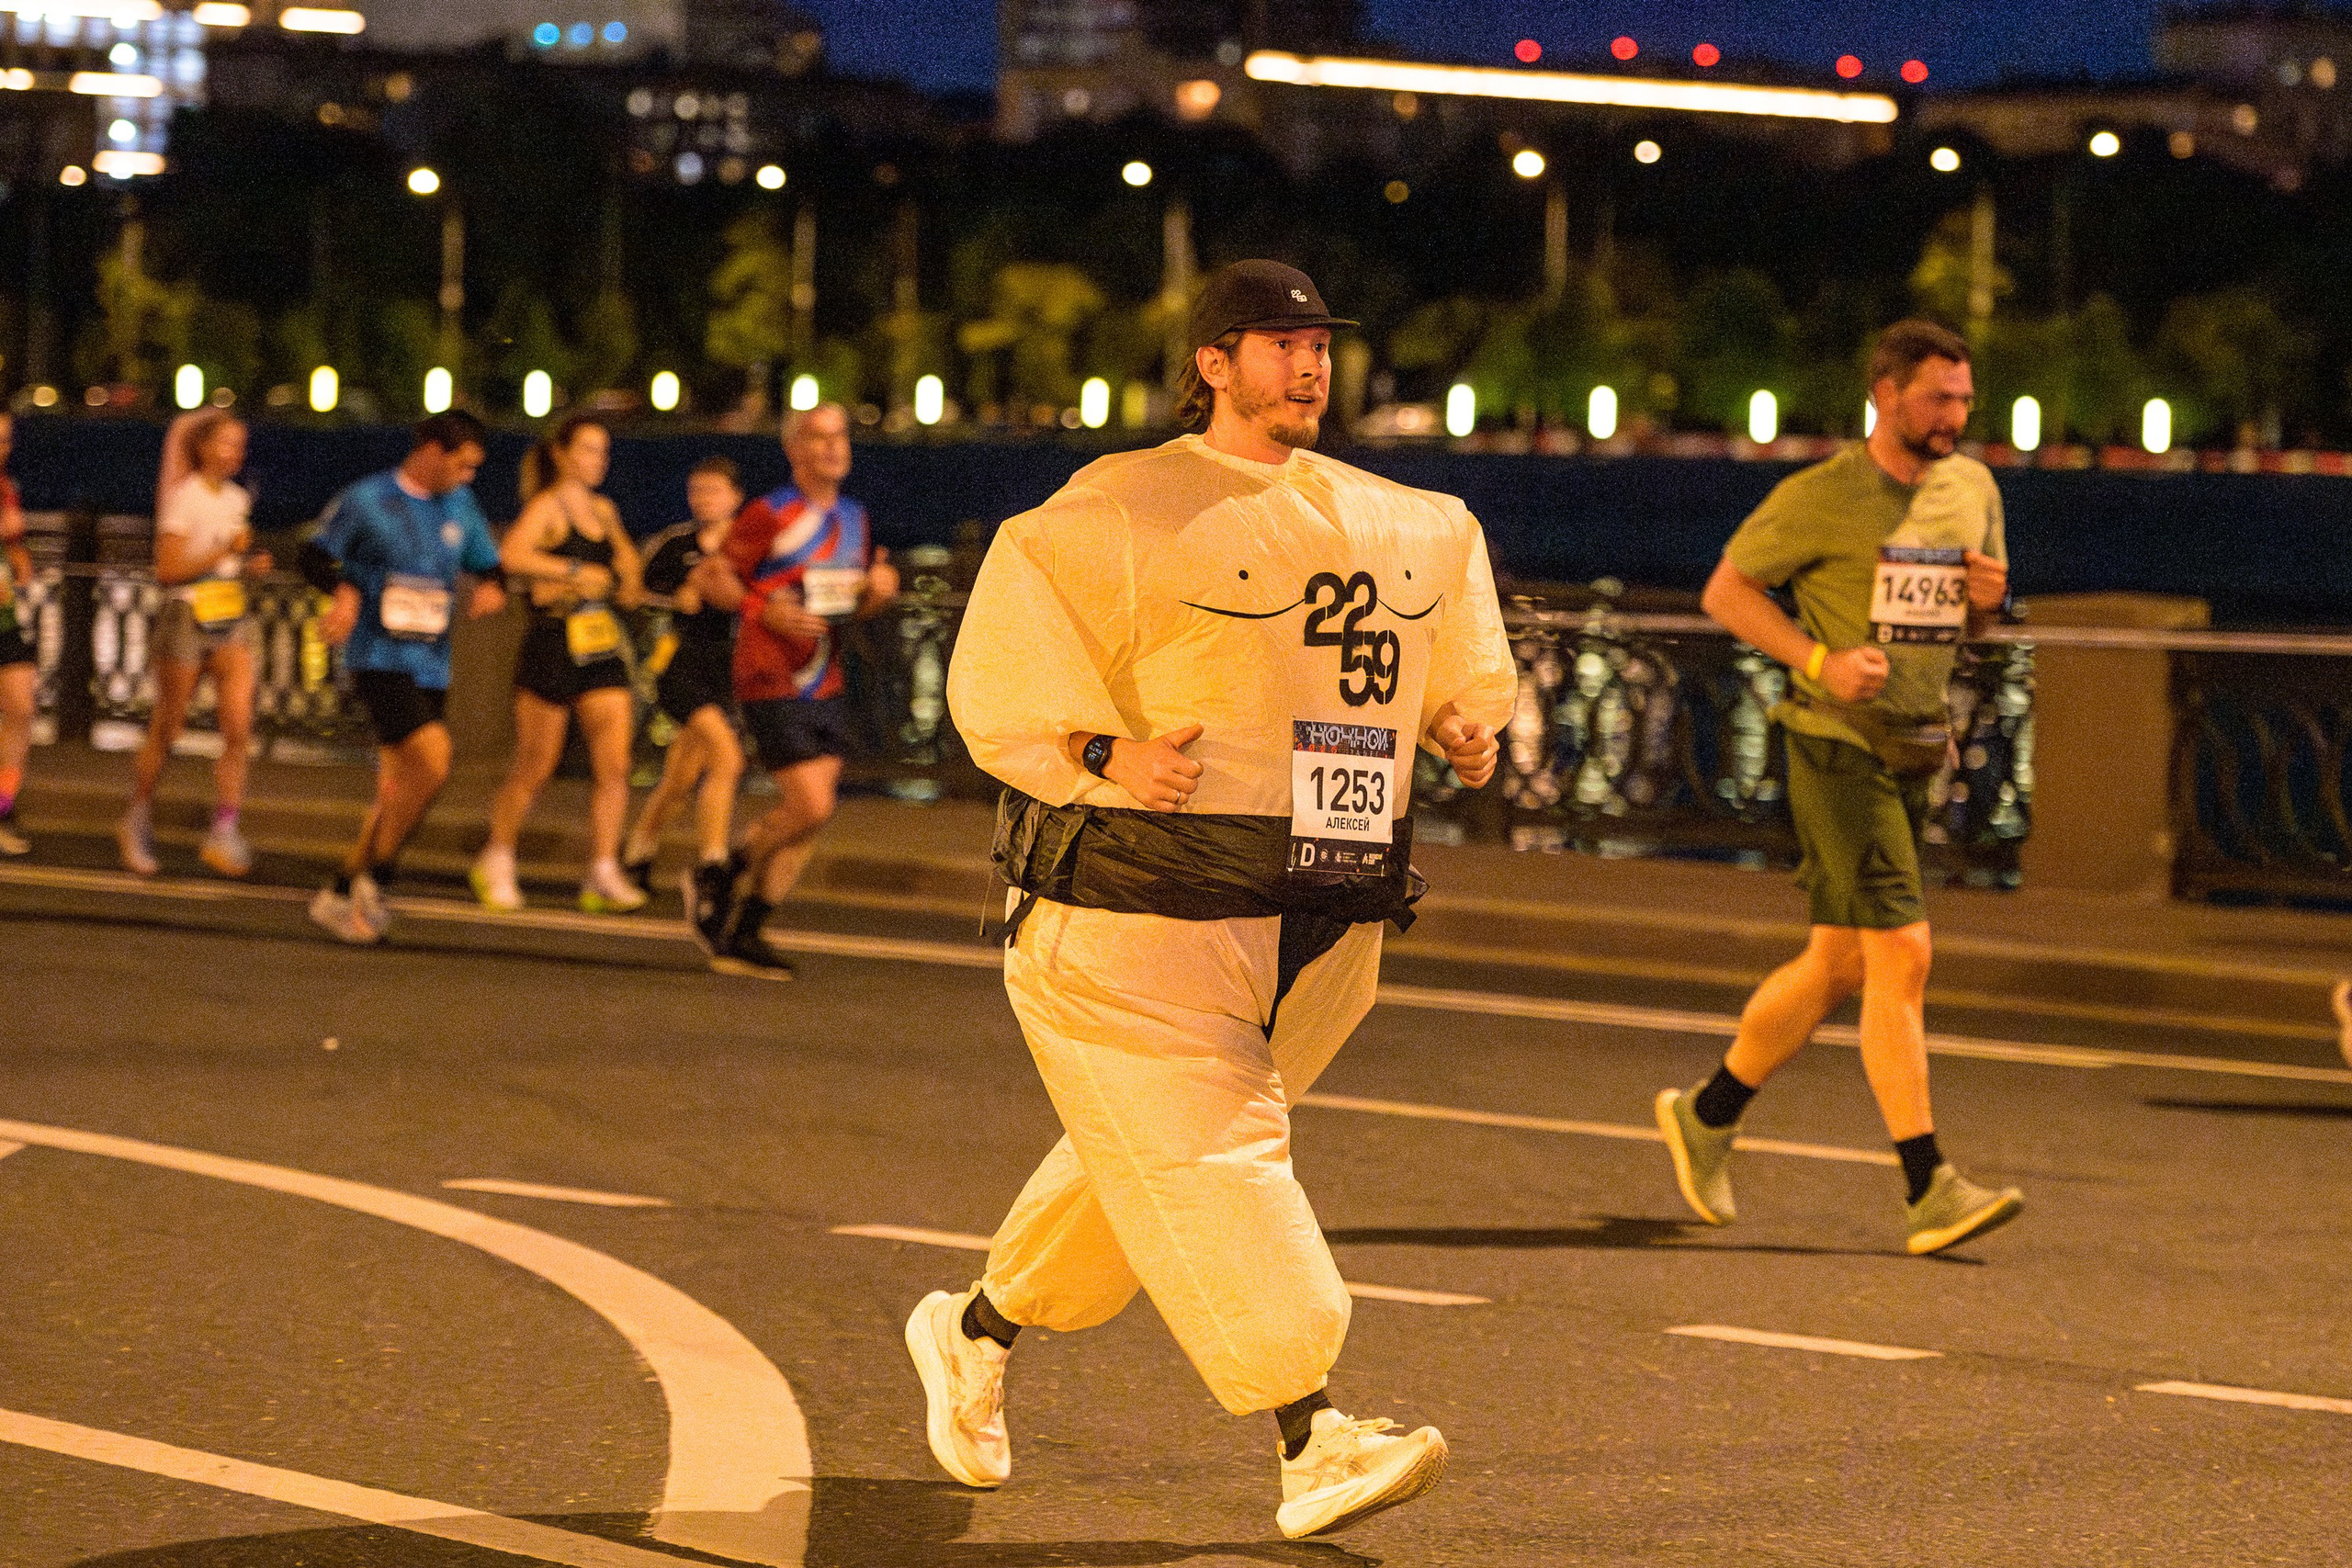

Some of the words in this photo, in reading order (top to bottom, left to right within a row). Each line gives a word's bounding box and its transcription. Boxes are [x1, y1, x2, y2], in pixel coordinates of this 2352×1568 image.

[1304, 570, 1377, 647] 22
[1883, 576, 1966, 607] 14963
[1339, 629, 1400, 706] 59
[1310, 766, 1385, 815] 1253
[1326, 817, 1370, 831] АЛЕКСЕЙ
[1299, 842, 1316, 866] D
